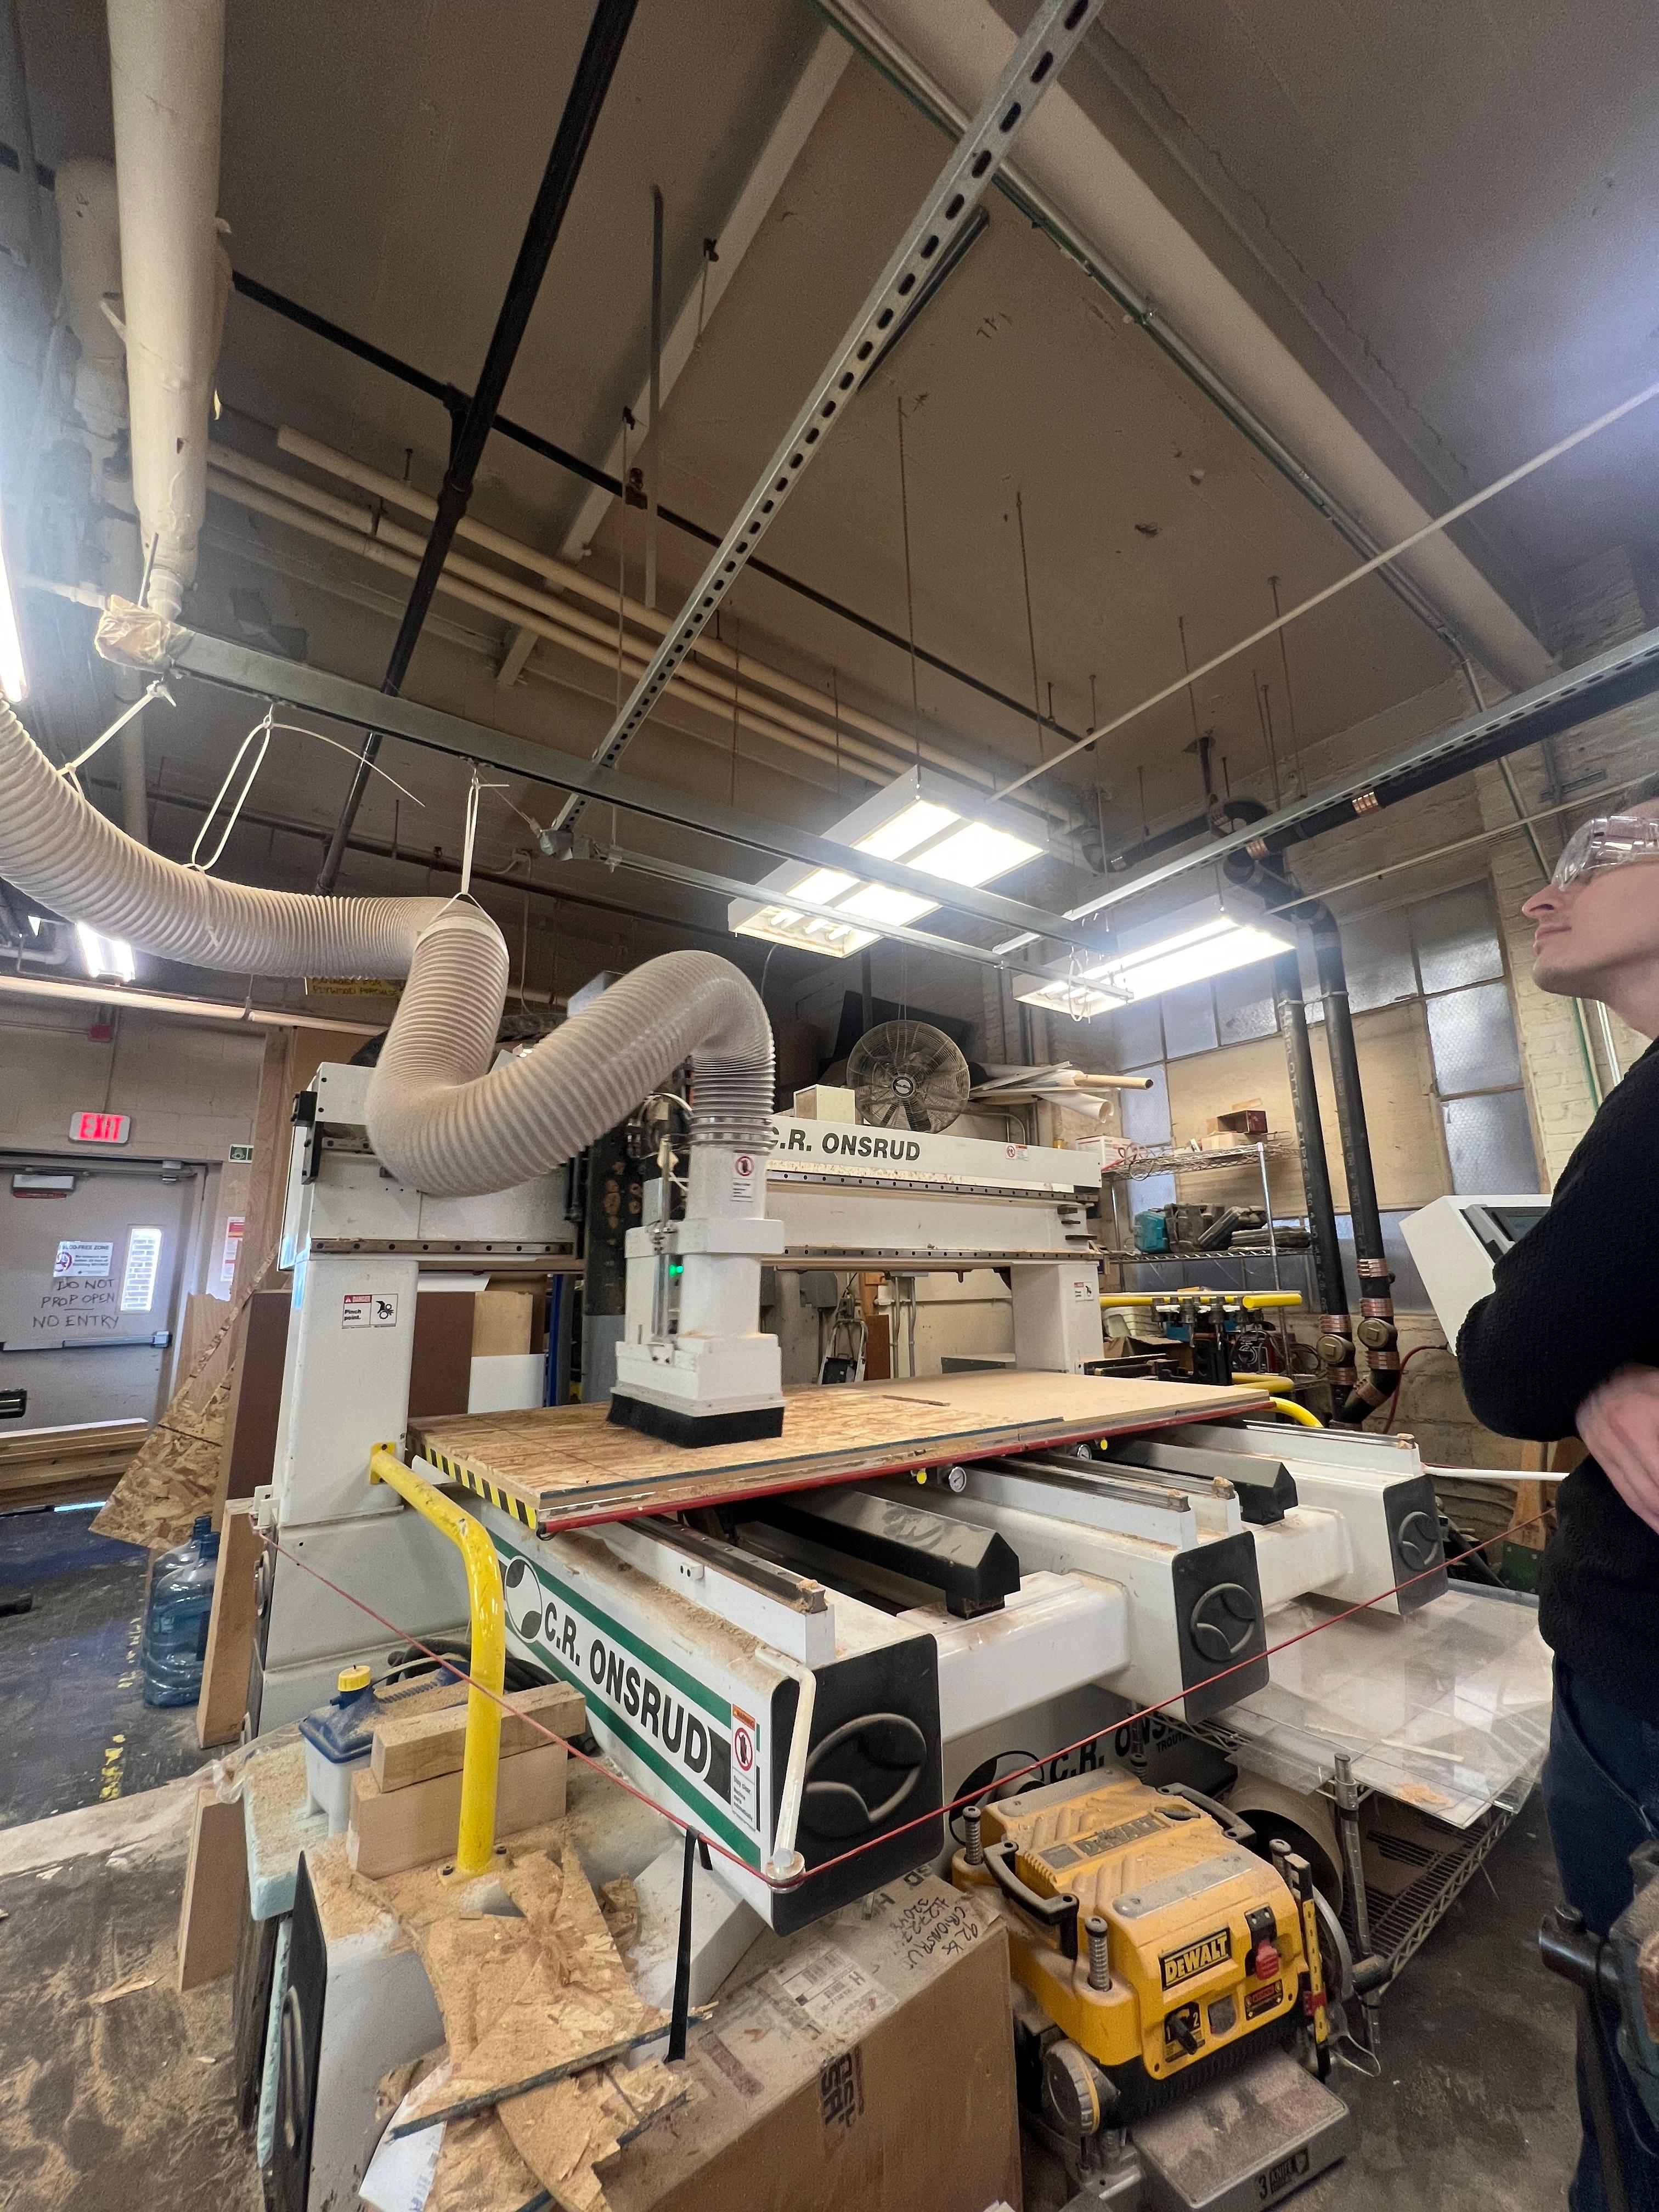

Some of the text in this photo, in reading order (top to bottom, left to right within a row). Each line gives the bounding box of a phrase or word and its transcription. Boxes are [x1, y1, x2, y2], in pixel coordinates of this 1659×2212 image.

[79, 1112, 124, 1141] EXIT
[822, 1133, 920, 1161] ONSRUD
[57, 1278, 116, 1291] DO NOT
[41, 1293, 115, 1308] PROP OPEN
[33, 1315, 119, 1328] NO ENTRY
[544, 1601, 708, 1773] C.R. ONSRUD
[1193, 2012, 1199, 2027] 2
